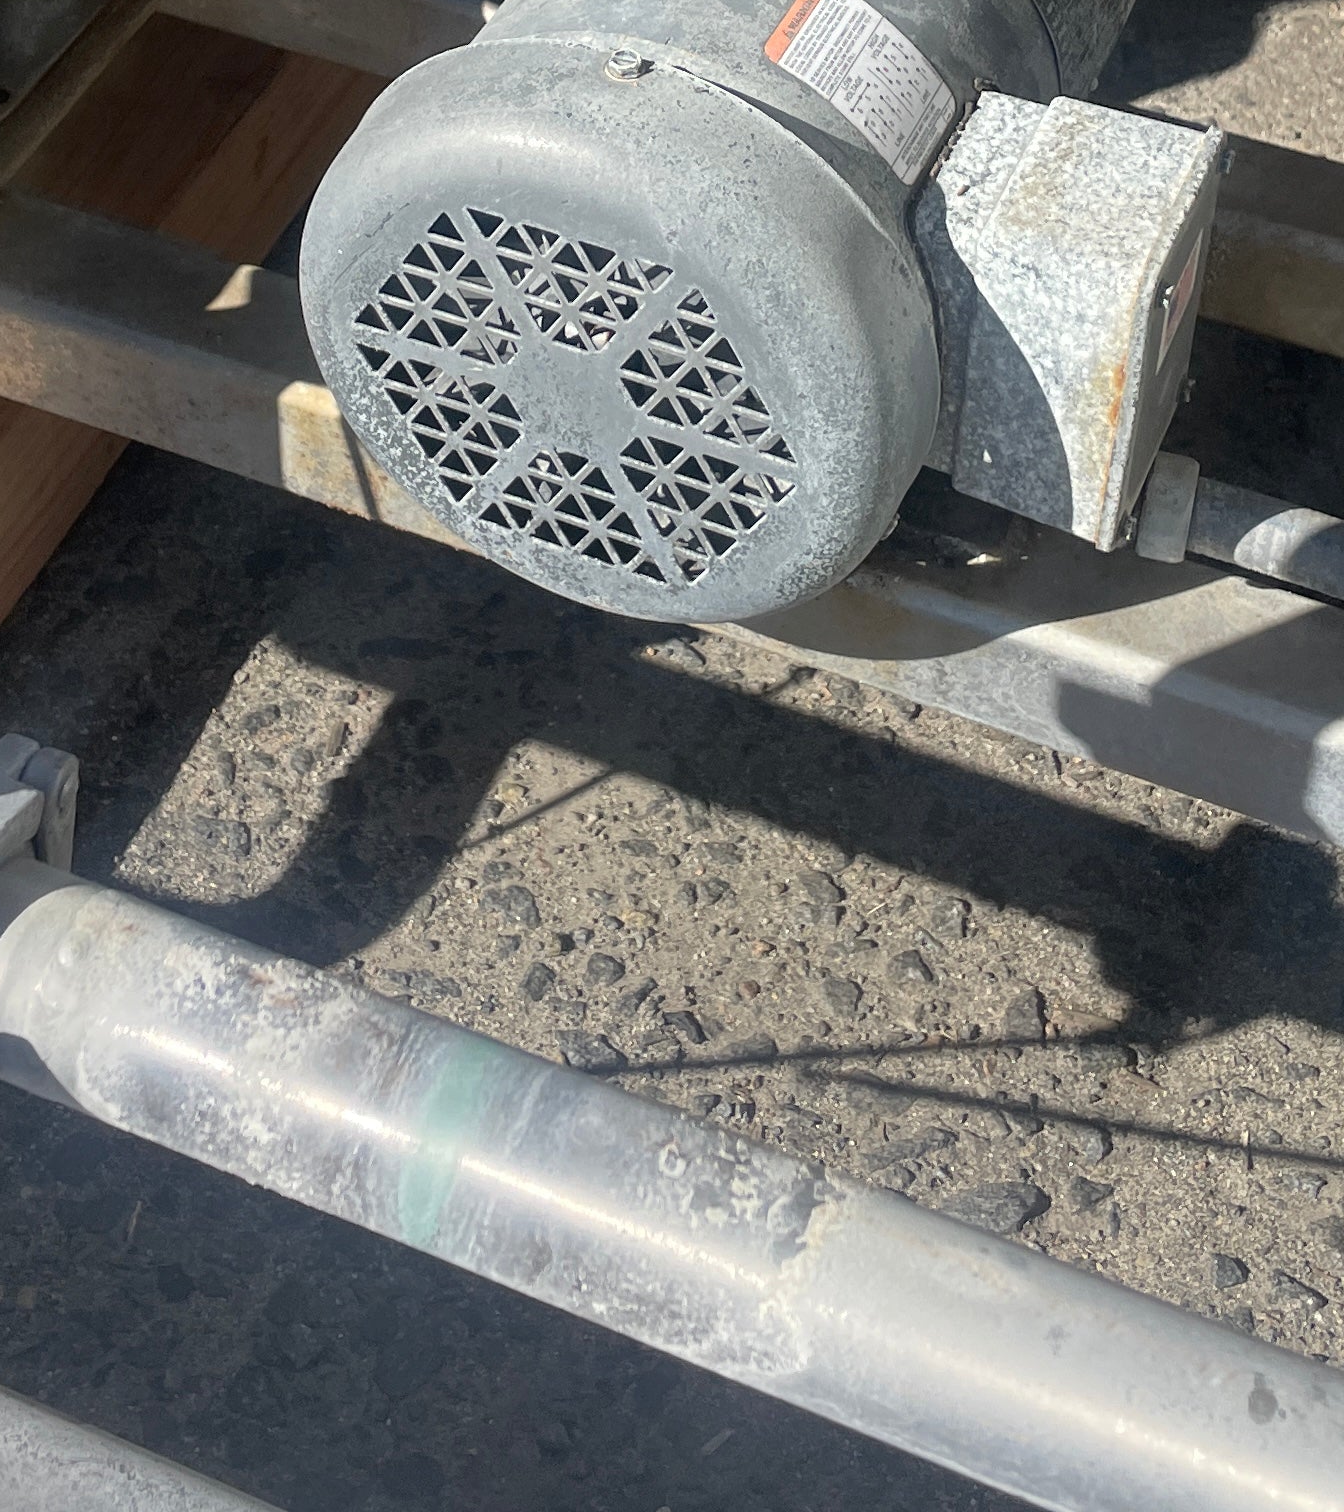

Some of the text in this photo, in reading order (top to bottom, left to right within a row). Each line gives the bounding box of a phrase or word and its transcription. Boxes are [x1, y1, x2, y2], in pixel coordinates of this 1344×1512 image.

[866, 32, 881, 49] HIGH
[869, 32, 891, 60] VOLTAGE
[839, 74, 854, 91] LOW
[842, 74, 864, 103] VOLTAGE
